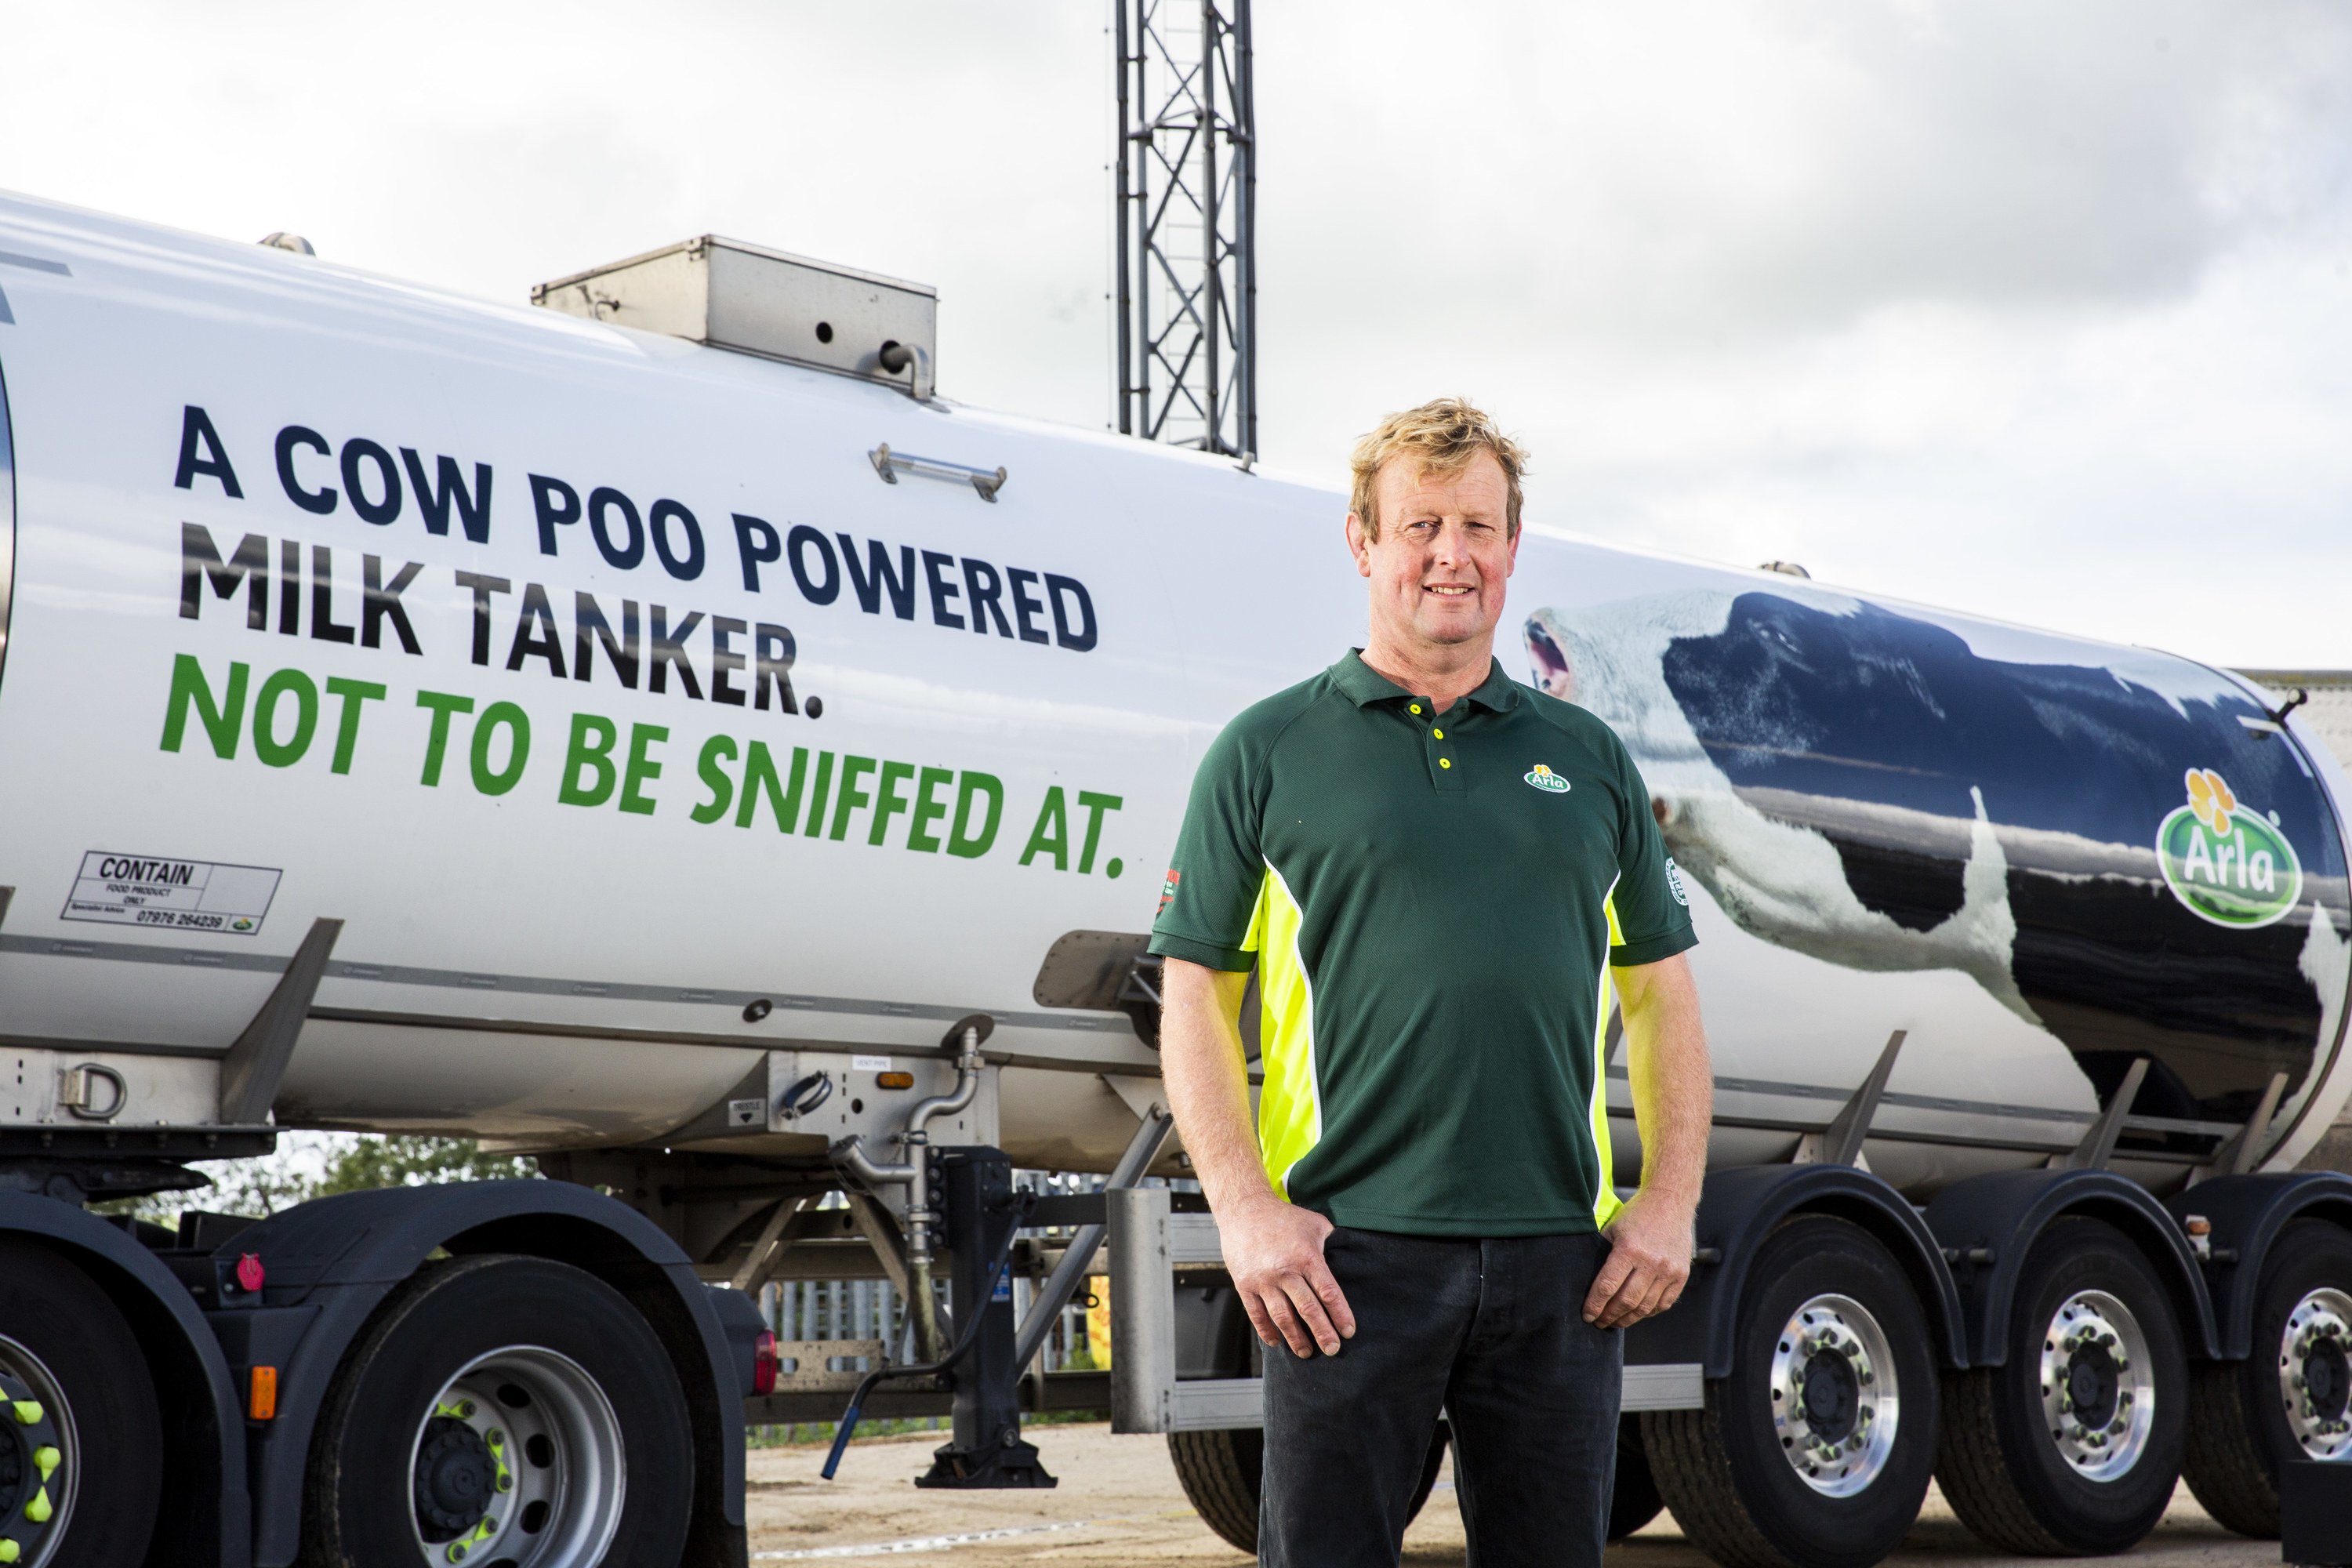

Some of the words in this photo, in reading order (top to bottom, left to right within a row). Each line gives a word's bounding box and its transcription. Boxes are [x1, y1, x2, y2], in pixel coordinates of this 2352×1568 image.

[174, 405, 245, 499] A
[274, 426, 493, 545] COW
[527, 474, 706, 582] POO
[731, 514, 1098, 653] POWERED
[180, 522, 425, 656] MILK
[456, 570, 823, 720] TANKER.
[160, 653, 387, 775] NOT
[417, 690, 531, 796] TO
[559, 713, 670, 815] BE
[691, 735, 1004, 858] SNIFFED
[1019, 786, 1123, 879] AT.
[1532, 773, 1564, 789] Arla
[100, 857, 194, 885] CONTAIN
[2183, 825, 2275, 893] Arla
[106, 884, 130, 894] FOOD
[132, 887, 172, 897] PRODUCT
[123, 895, 146, 905] ONLY
[136, 909, 176, 924] 07976
